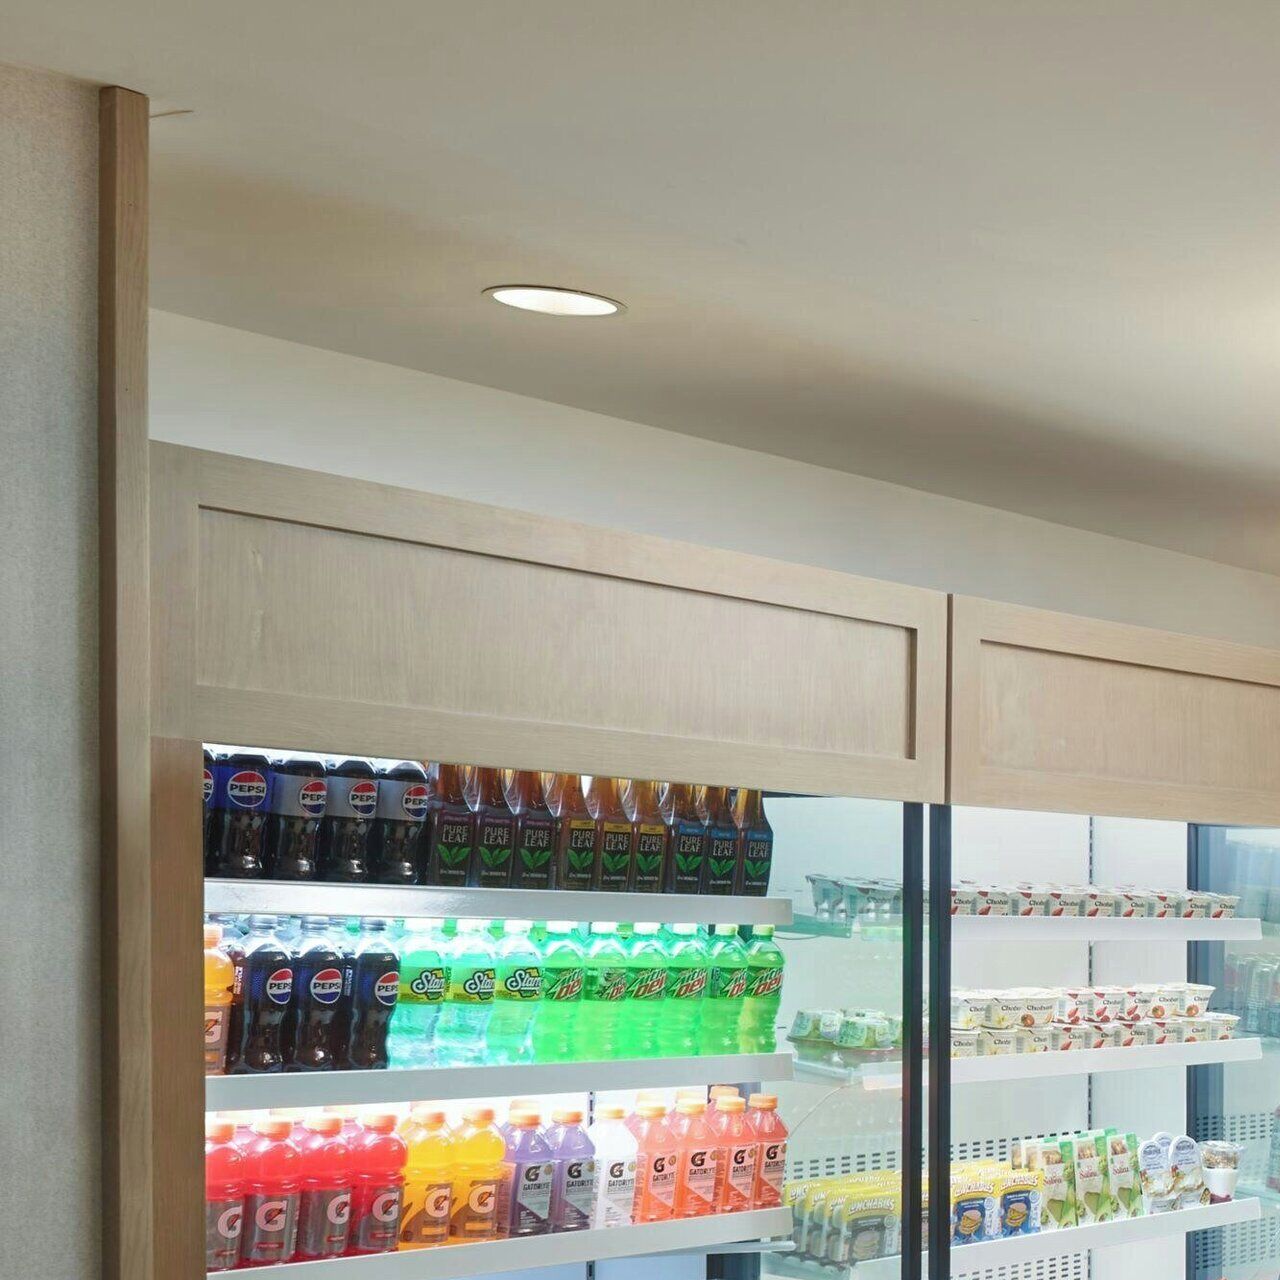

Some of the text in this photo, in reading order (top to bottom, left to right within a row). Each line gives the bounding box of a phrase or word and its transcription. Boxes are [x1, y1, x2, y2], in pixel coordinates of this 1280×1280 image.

[230, 785, 265, 794] PEPSI
[302, 793, 325, 801] PEPS
[351, 794, 376, 802] PEPS
[484, 827, 510, 836] PURE
[524, 829, 551, 839] PURE
[483, 835, 509, 845] LEAF
[524, 837, 550, 848] LEAF
